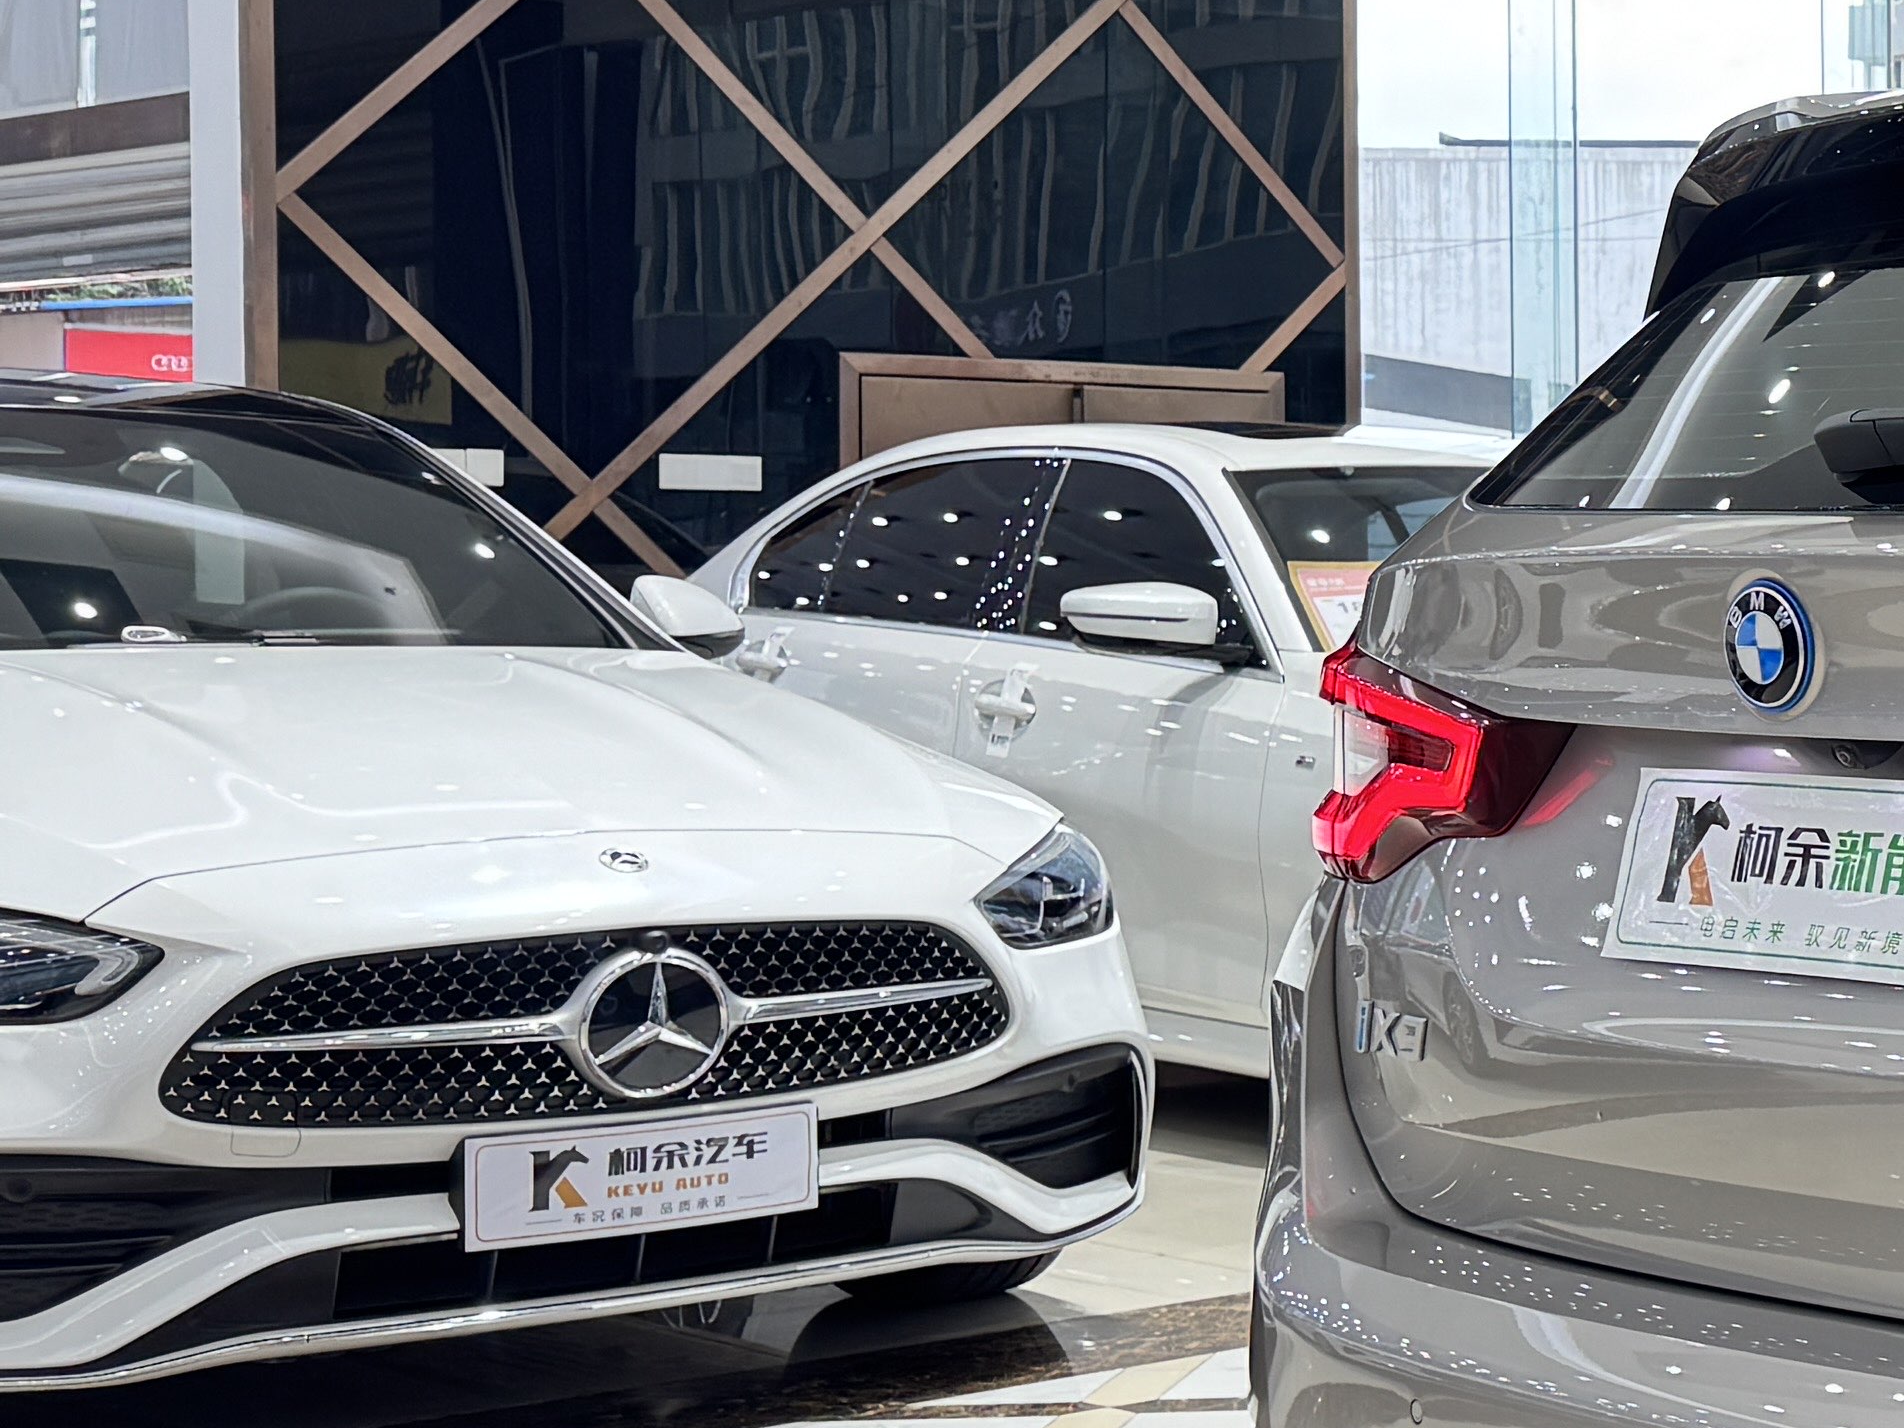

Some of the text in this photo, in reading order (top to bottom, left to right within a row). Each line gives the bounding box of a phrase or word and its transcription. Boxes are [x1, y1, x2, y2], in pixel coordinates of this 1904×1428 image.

[1729, 591, 1792, 630] BMW
[1700, 915, 1903, 955] 电启未来 驭见新境
[608, 1131, 768, 1177] 柯余汽车
[607, 1172, 729, 1199] KEYU AUTO
